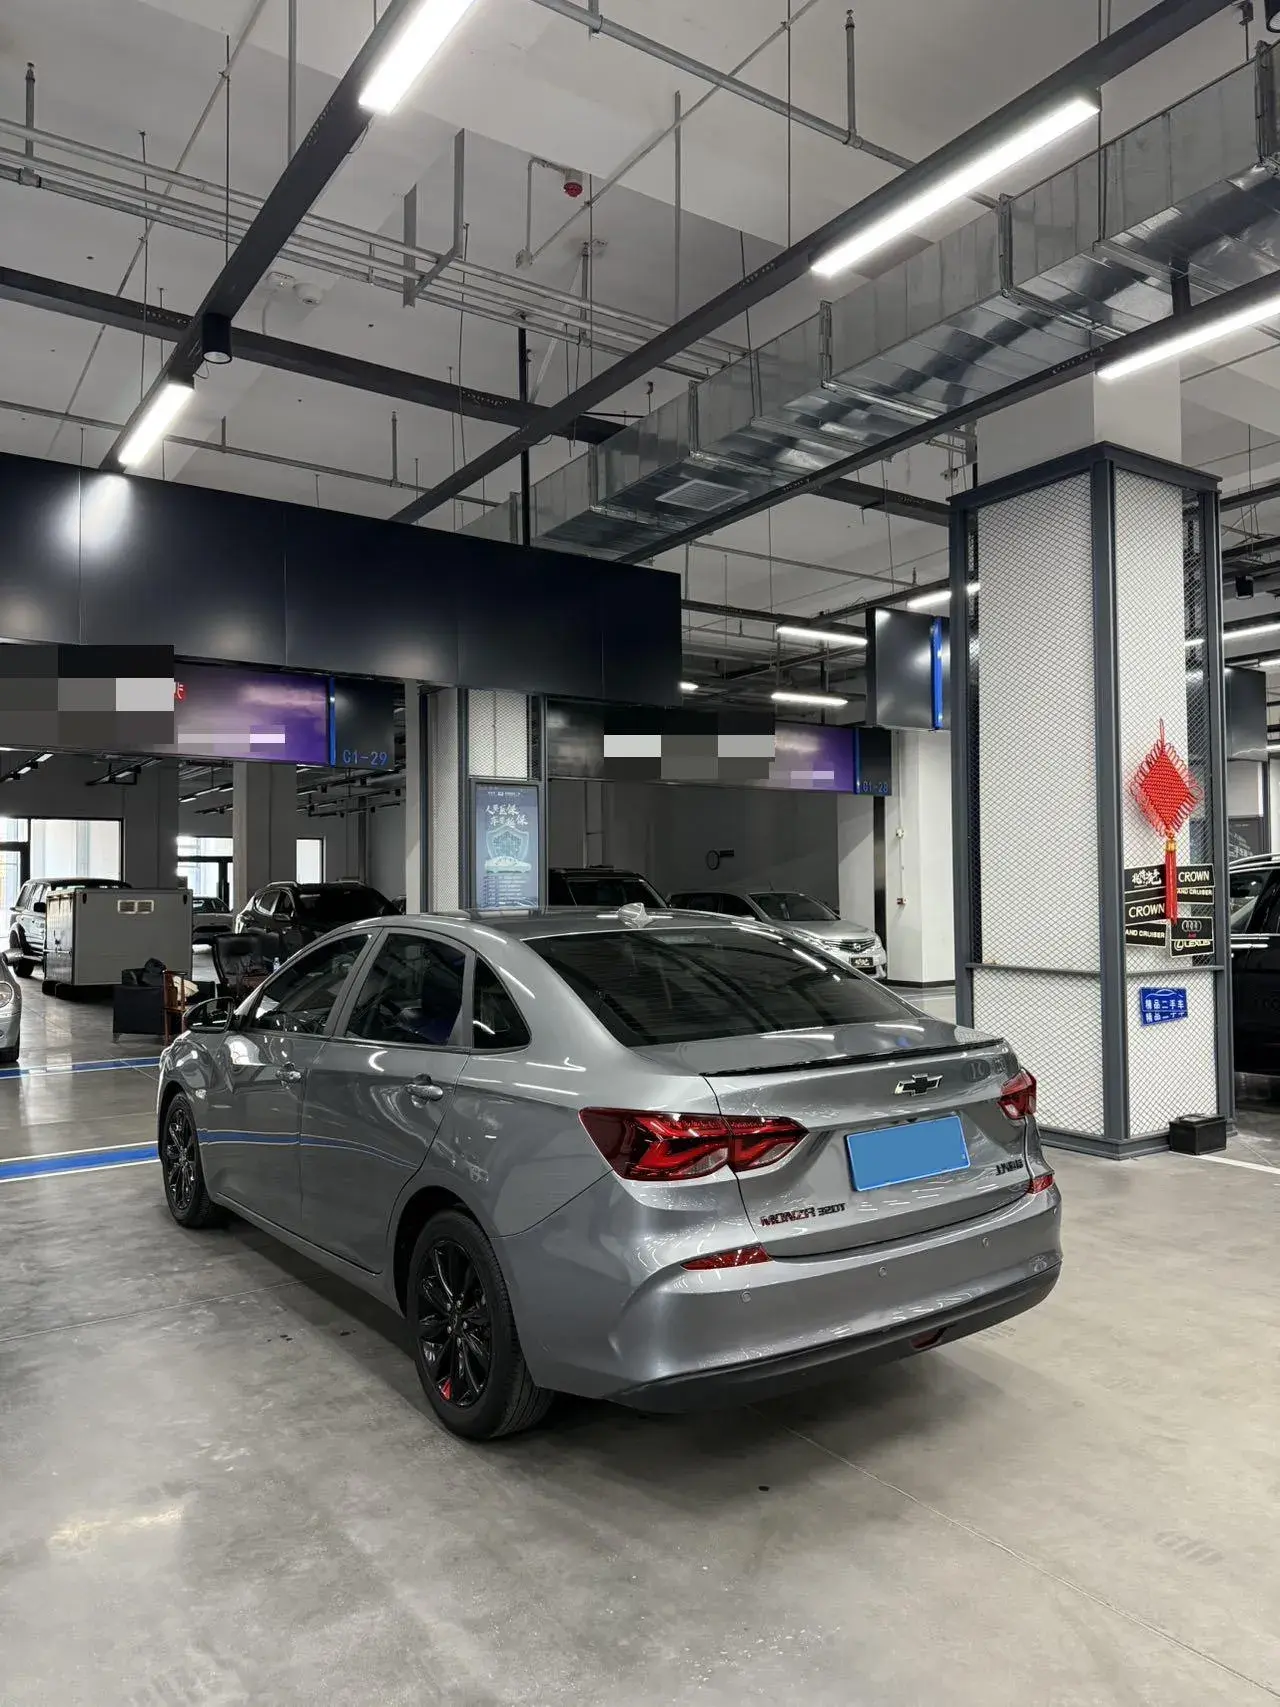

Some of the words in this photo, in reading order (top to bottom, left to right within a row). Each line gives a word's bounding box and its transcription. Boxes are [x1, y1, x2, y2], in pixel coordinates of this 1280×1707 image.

[1178, 871, 1210, 882] CROWN
[1128, 903, 1165, 918] CROWN
[1139, 930, 1165, 938] CRUISER
[1145, 999, 1184, 1010] 精品二手车
[817, 1203, 846, 1217] 320T
